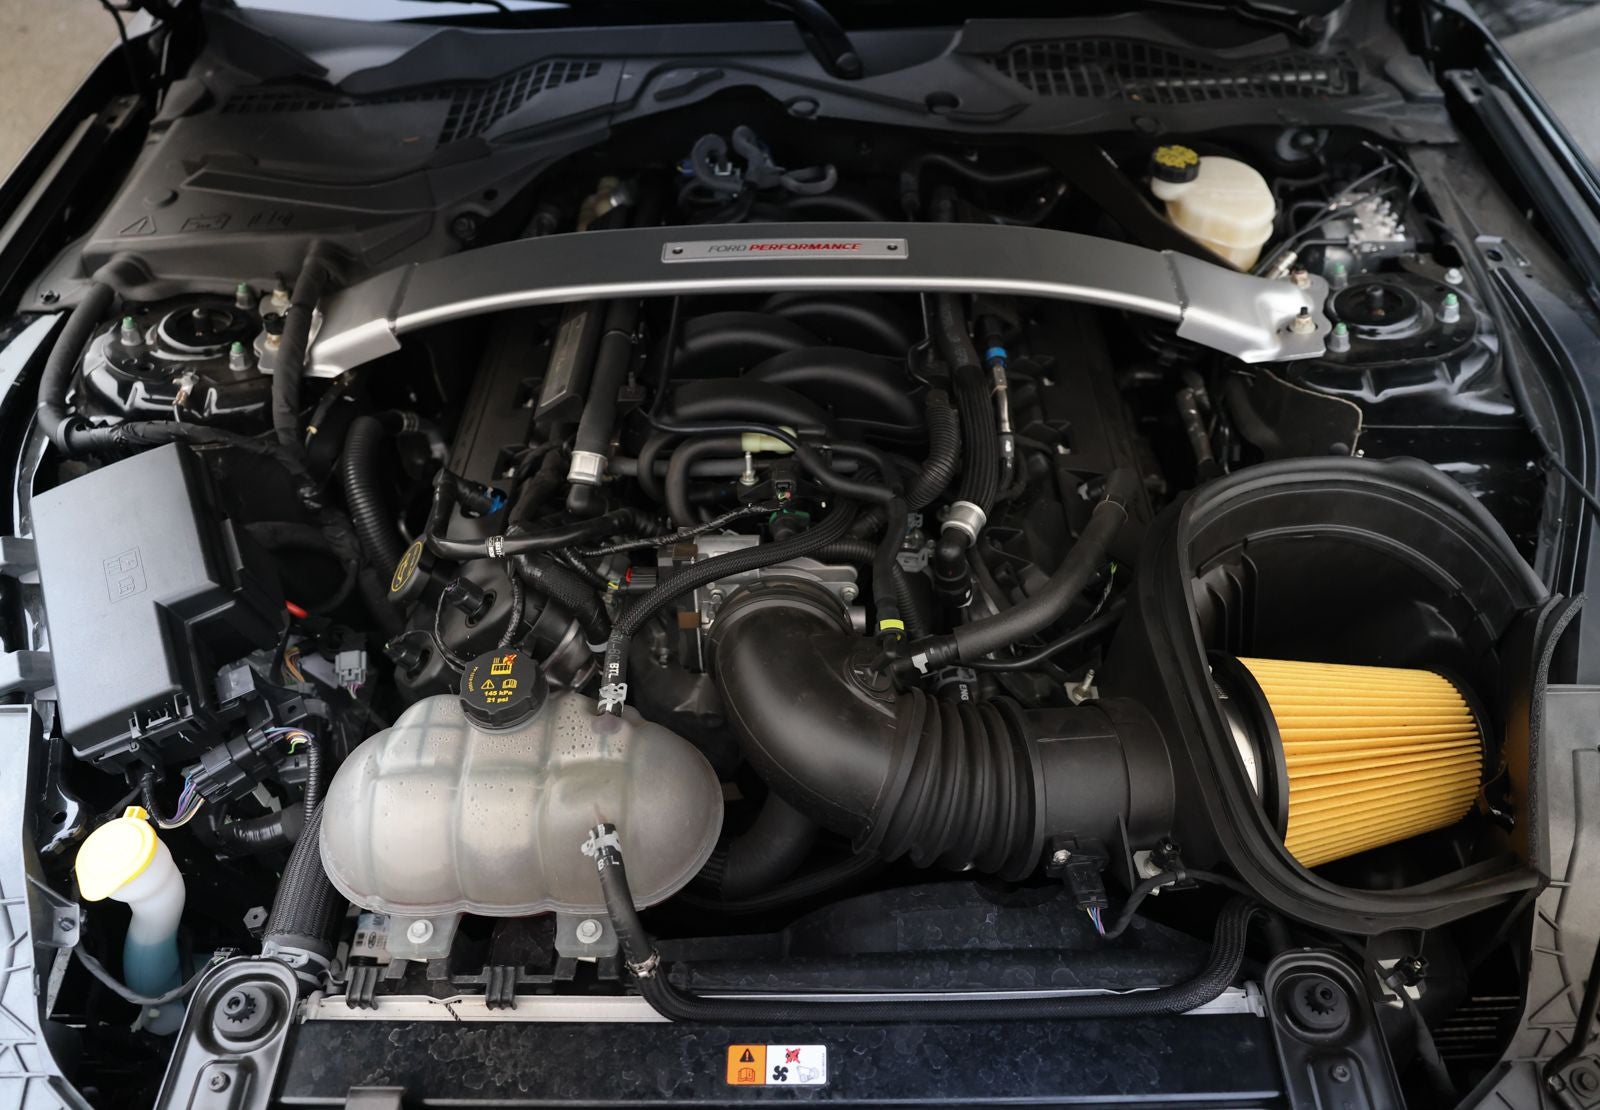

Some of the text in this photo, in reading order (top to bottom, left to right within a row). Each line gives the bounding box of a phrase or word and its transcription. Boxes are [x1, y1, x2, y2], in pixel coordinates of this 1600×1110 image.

[707, 243, 862, 253] FORD PERFORMANCE
[608, 662, 620, 679] BTL
[959, 684, 969, 701] ENG
